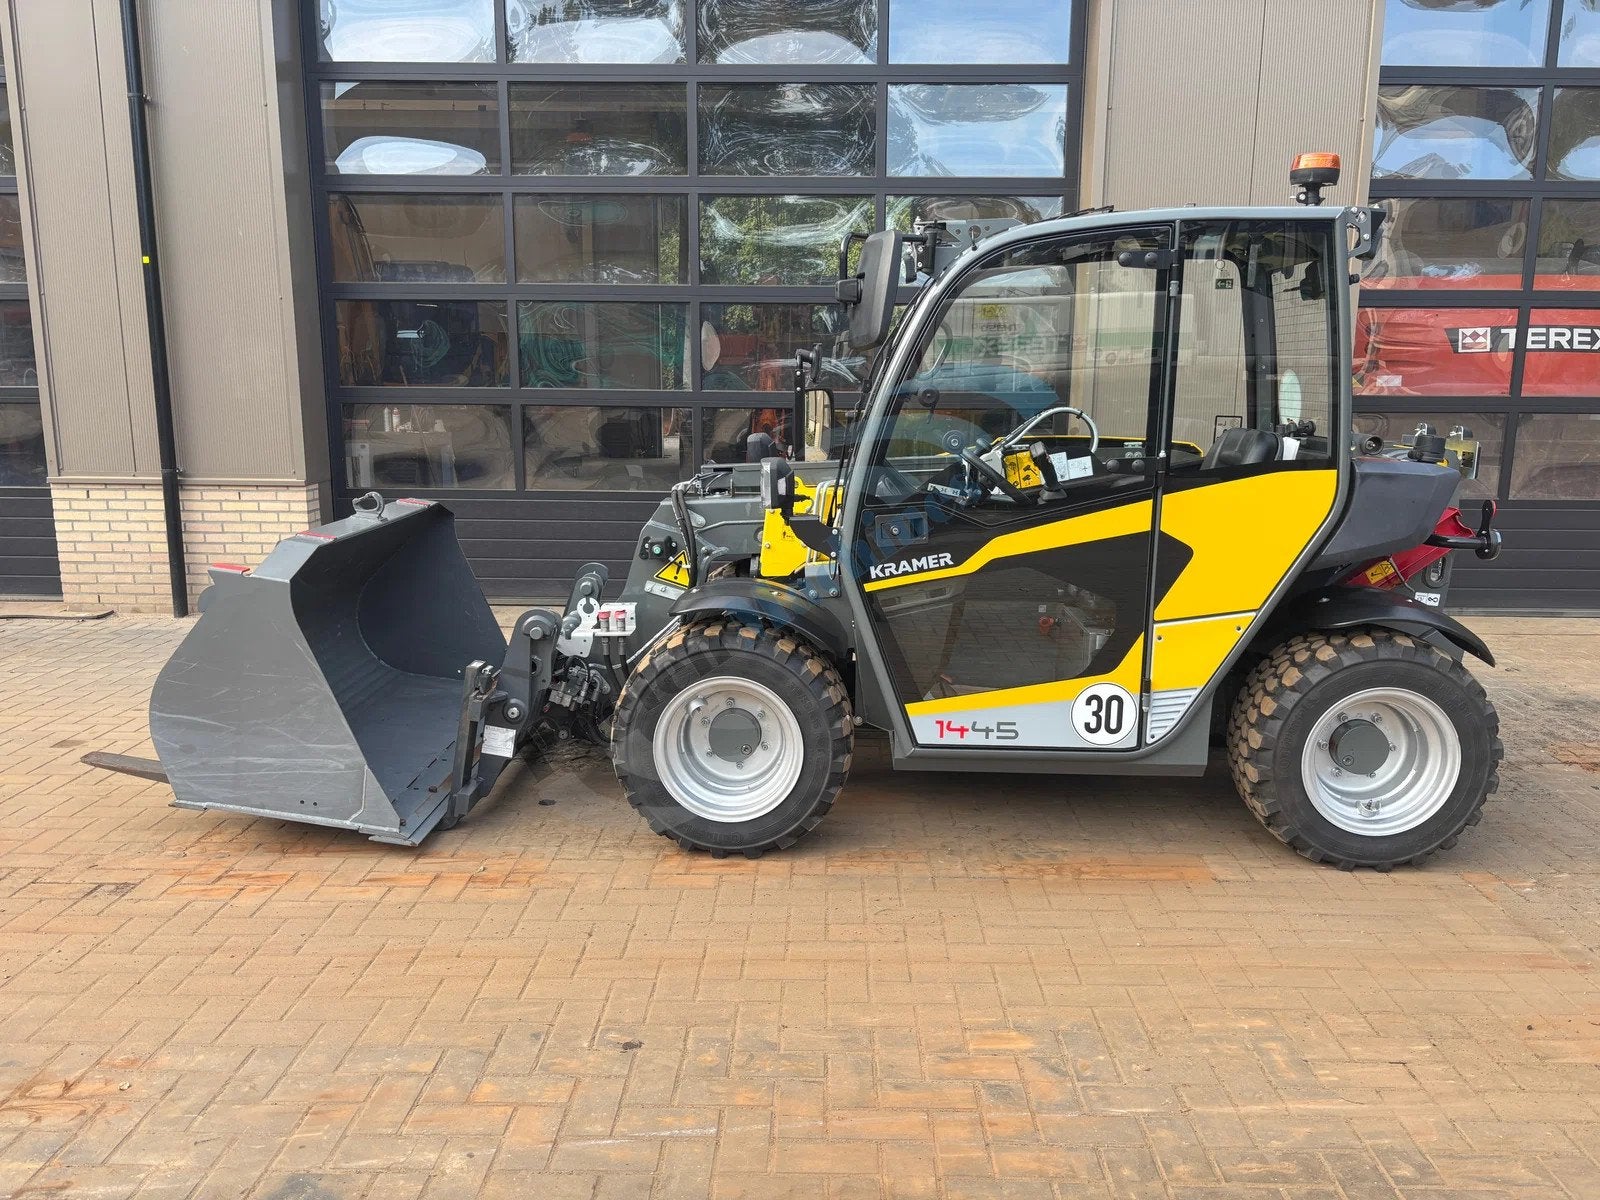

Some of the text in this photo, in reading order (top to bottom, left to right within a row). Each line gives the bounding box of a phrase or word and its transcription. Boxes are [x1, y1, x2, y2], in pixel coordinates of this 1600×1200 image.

[869, 552, 954, 579] KRAMER
[1084, 694, 1124, 735] 30
[935, 720, 1019, 740] 1445
